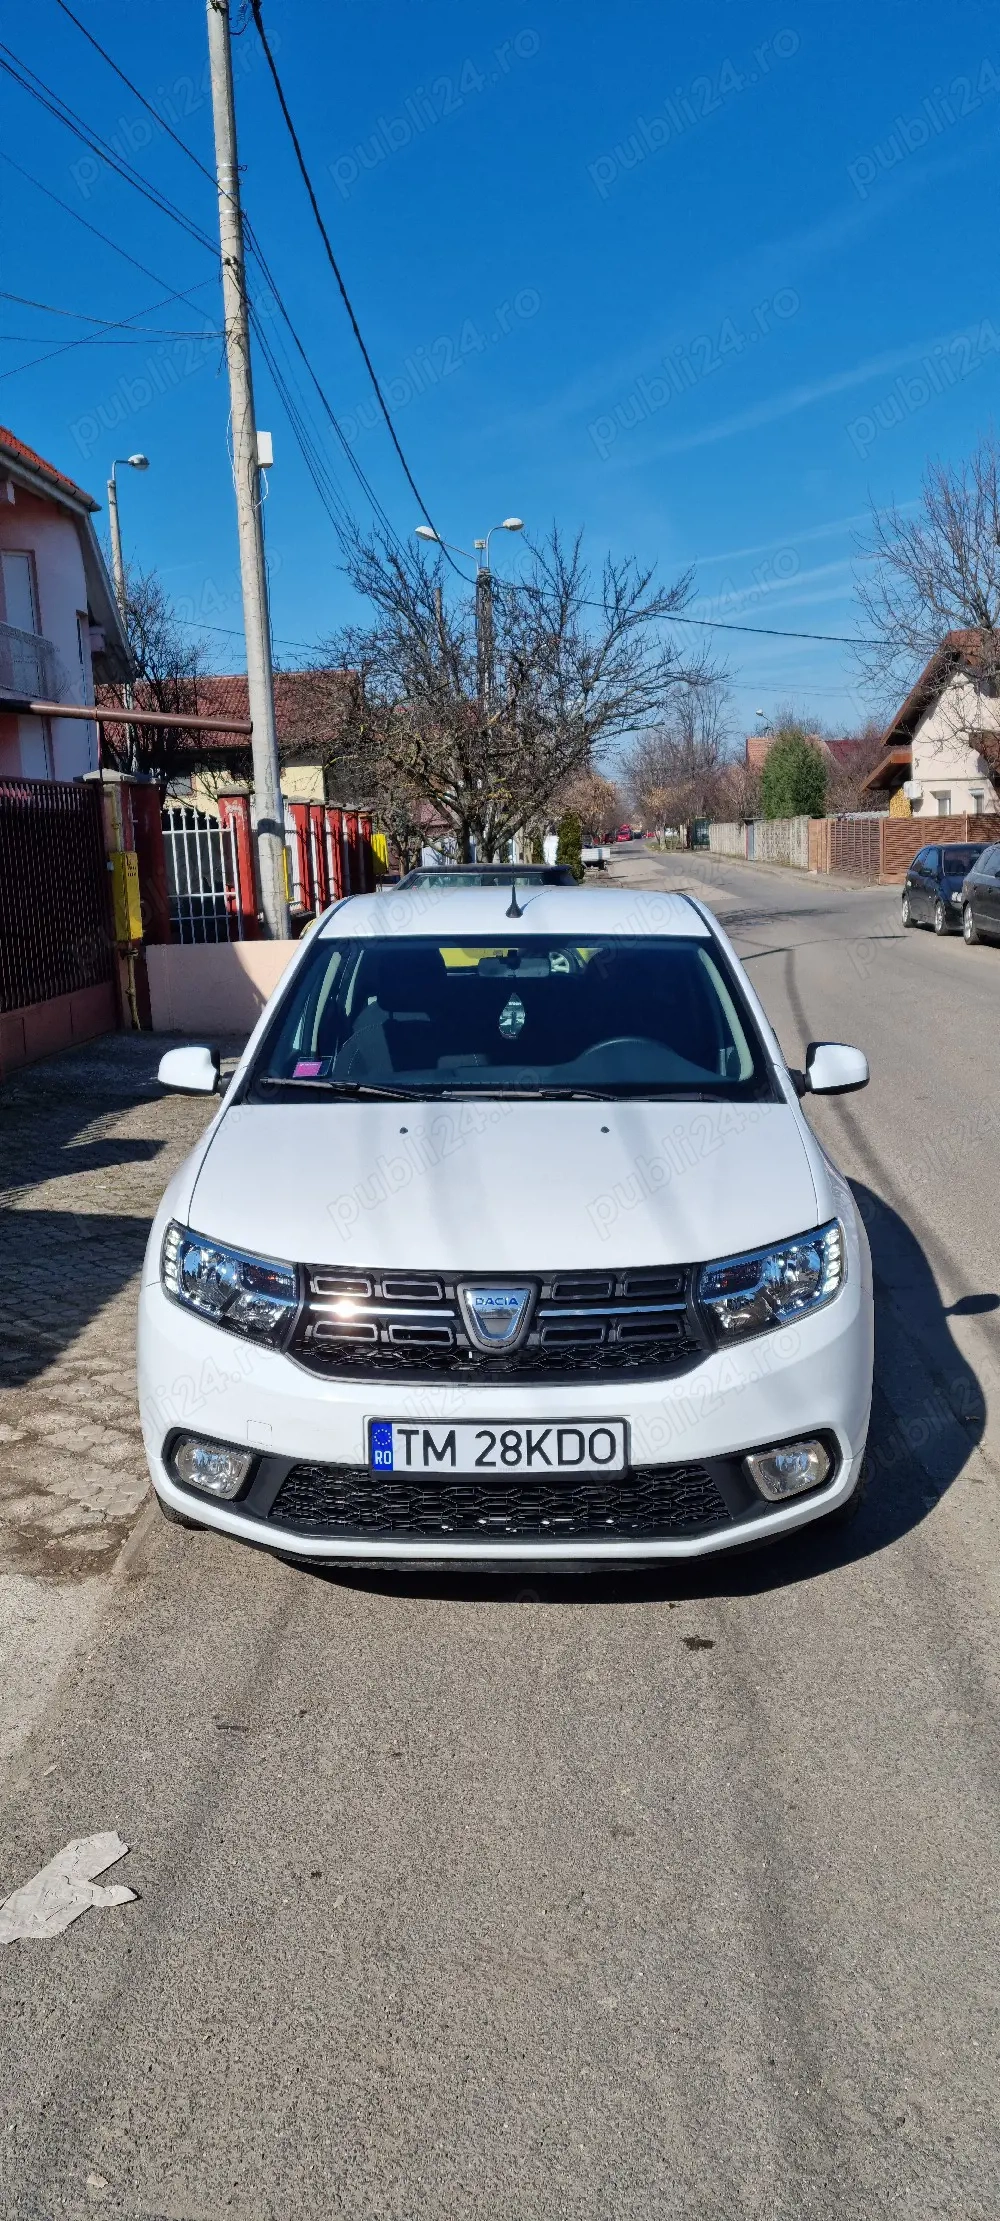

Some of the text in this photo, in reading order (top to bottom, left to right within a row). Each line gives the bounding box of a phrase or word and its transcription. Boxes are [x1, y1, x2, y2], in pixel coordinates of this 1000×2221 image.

[475, 1297, 519, 1306] DACIA
[374, 1428, 617, 1467] RO TM 28KDO
